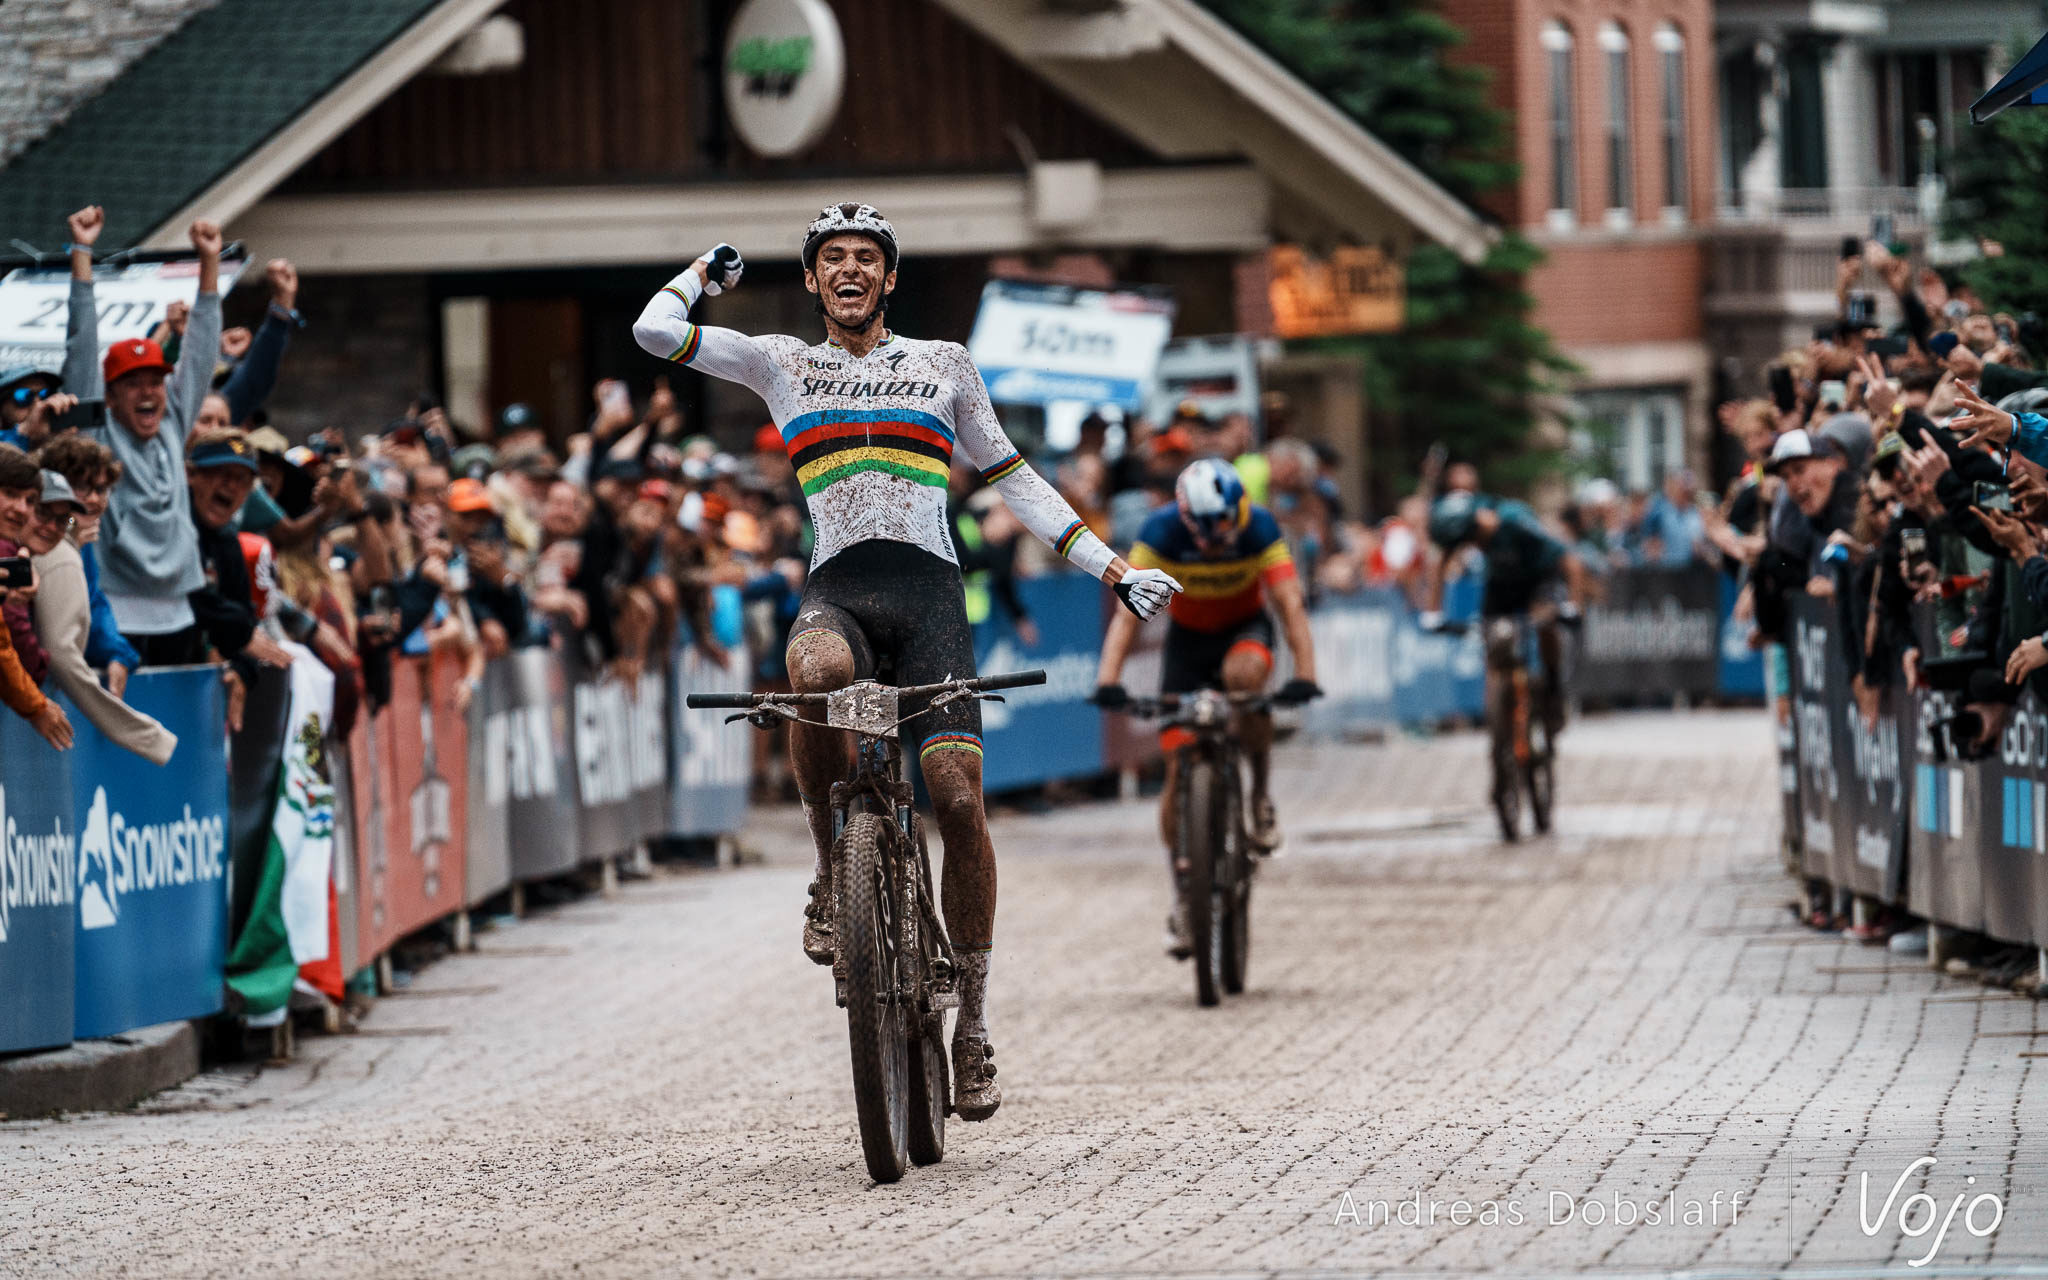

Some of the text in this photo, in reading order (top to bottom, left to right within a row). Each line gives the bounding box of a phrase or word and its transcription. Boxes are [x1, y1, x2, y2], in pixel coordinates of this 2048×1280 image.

[19, 297, 156, 328] 2m
[814, 361, 842, 371] UCI
[801, 377, 939, 399] SPECIALIZED
[111, 803, 224, 894] Snowshoe
